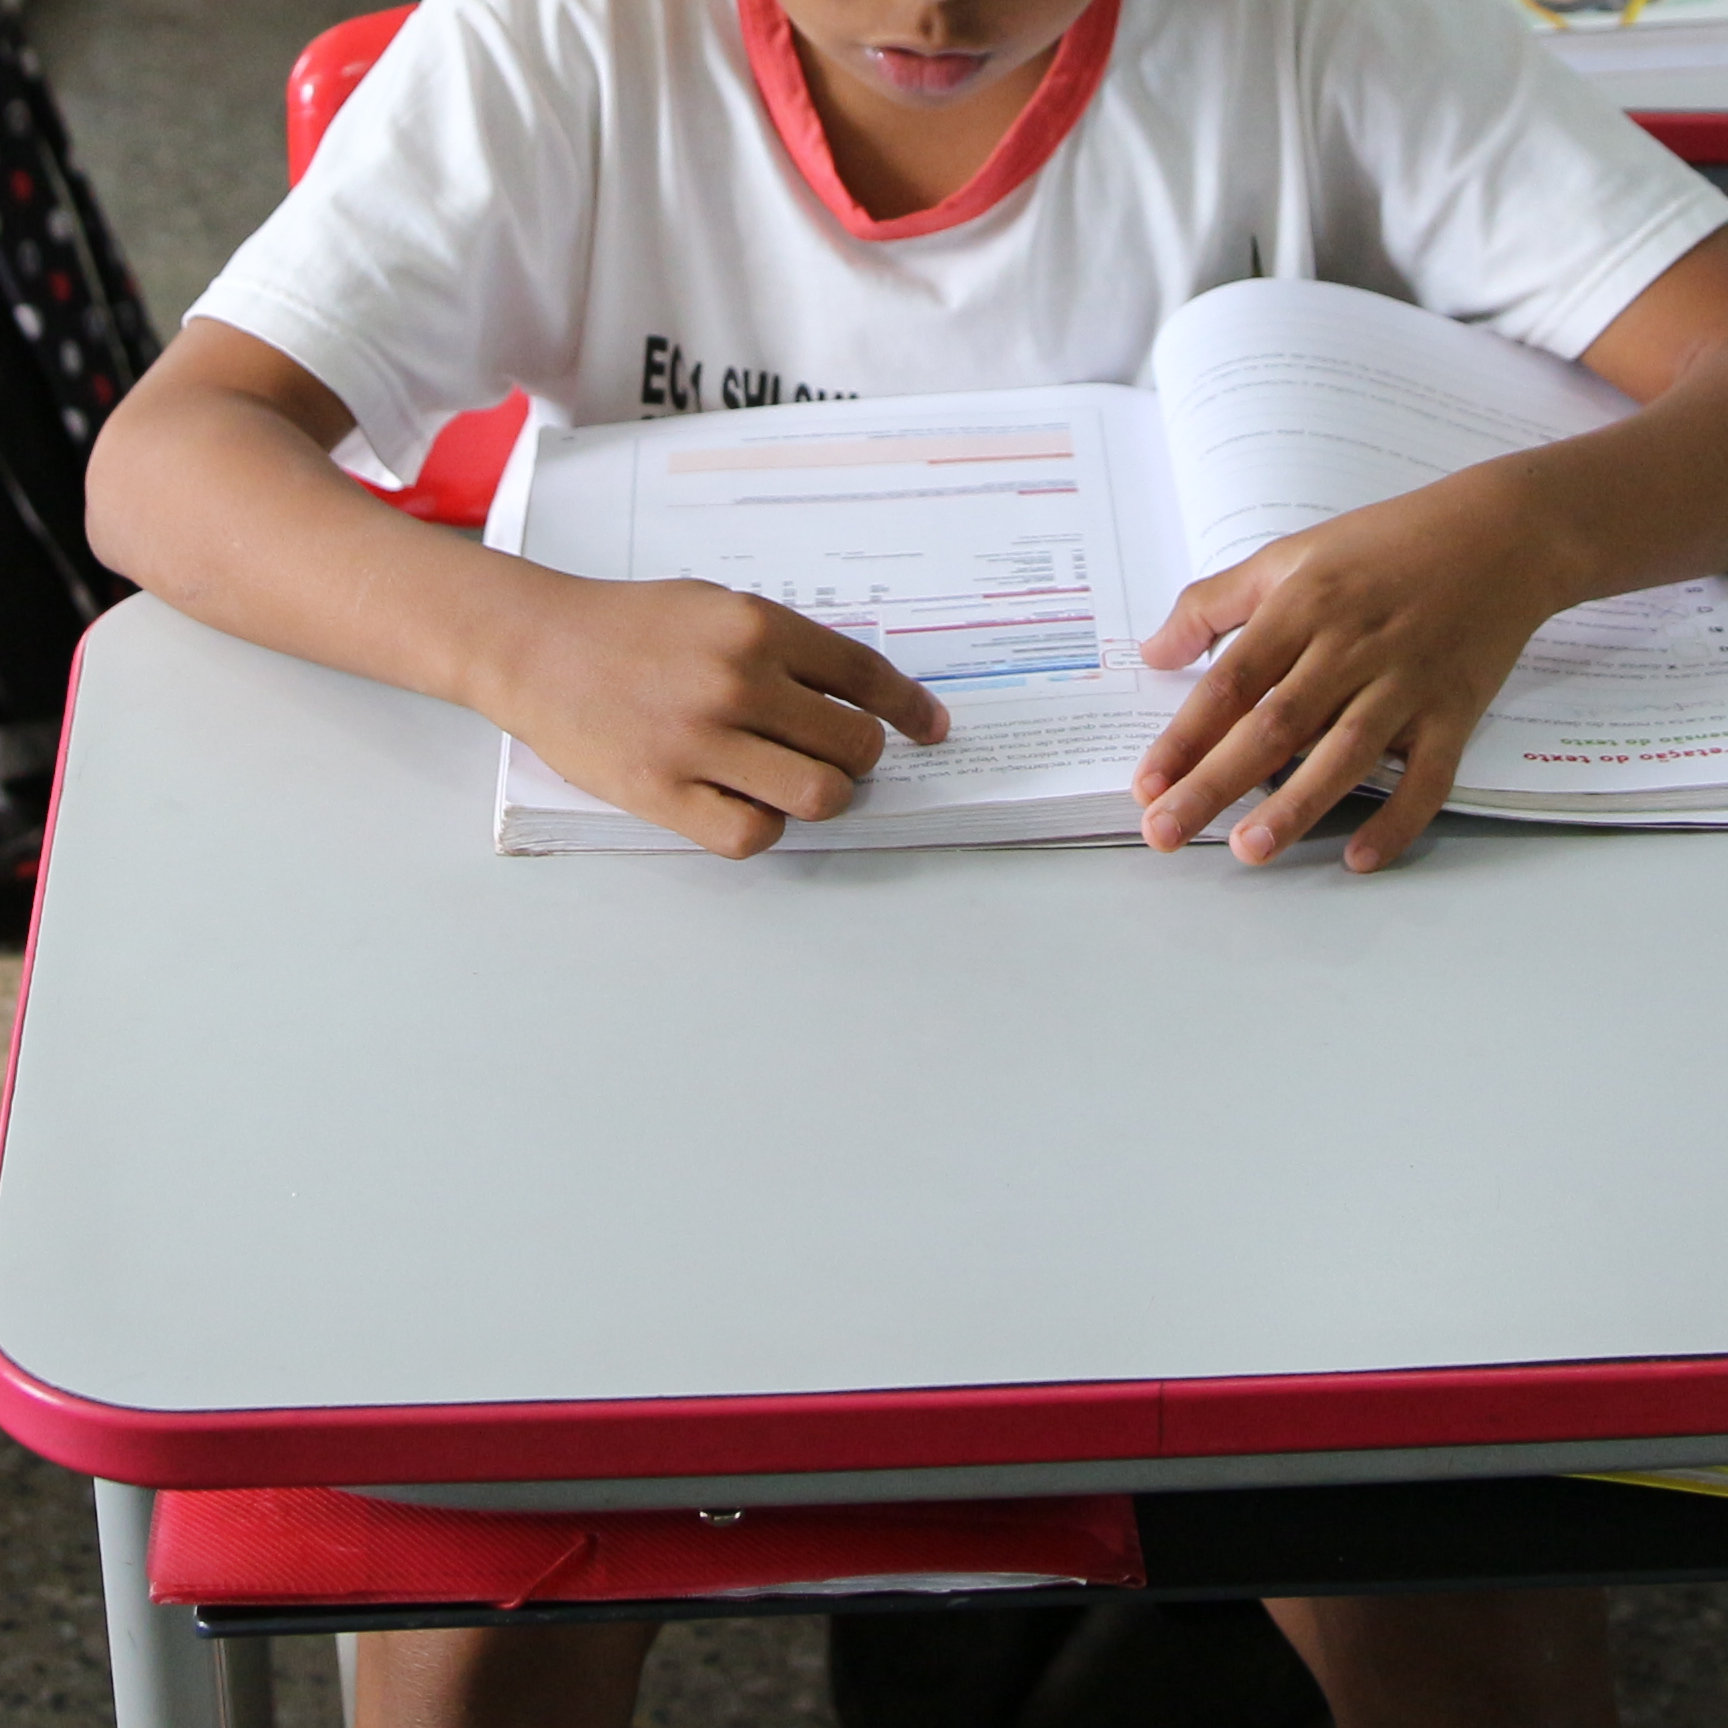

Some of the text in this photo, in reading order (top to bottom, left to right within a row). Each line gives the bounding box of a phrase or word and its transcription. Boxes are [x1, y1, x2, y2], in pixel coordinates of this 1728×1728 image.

[1070, 723, 1097, 732] que
[943, 734, 1009, 746] estrutura
[1560, 738, 1619, 746] texto
[1064, 746, 1118, 755] energia
[1077, 758, 1096, 766] de
[1523, 753, 1591, 764] texto
[1599, 754, 1630, 764] do
[990, 761, 1072, 774] reclamação
[917, 771, 951, 781] você
